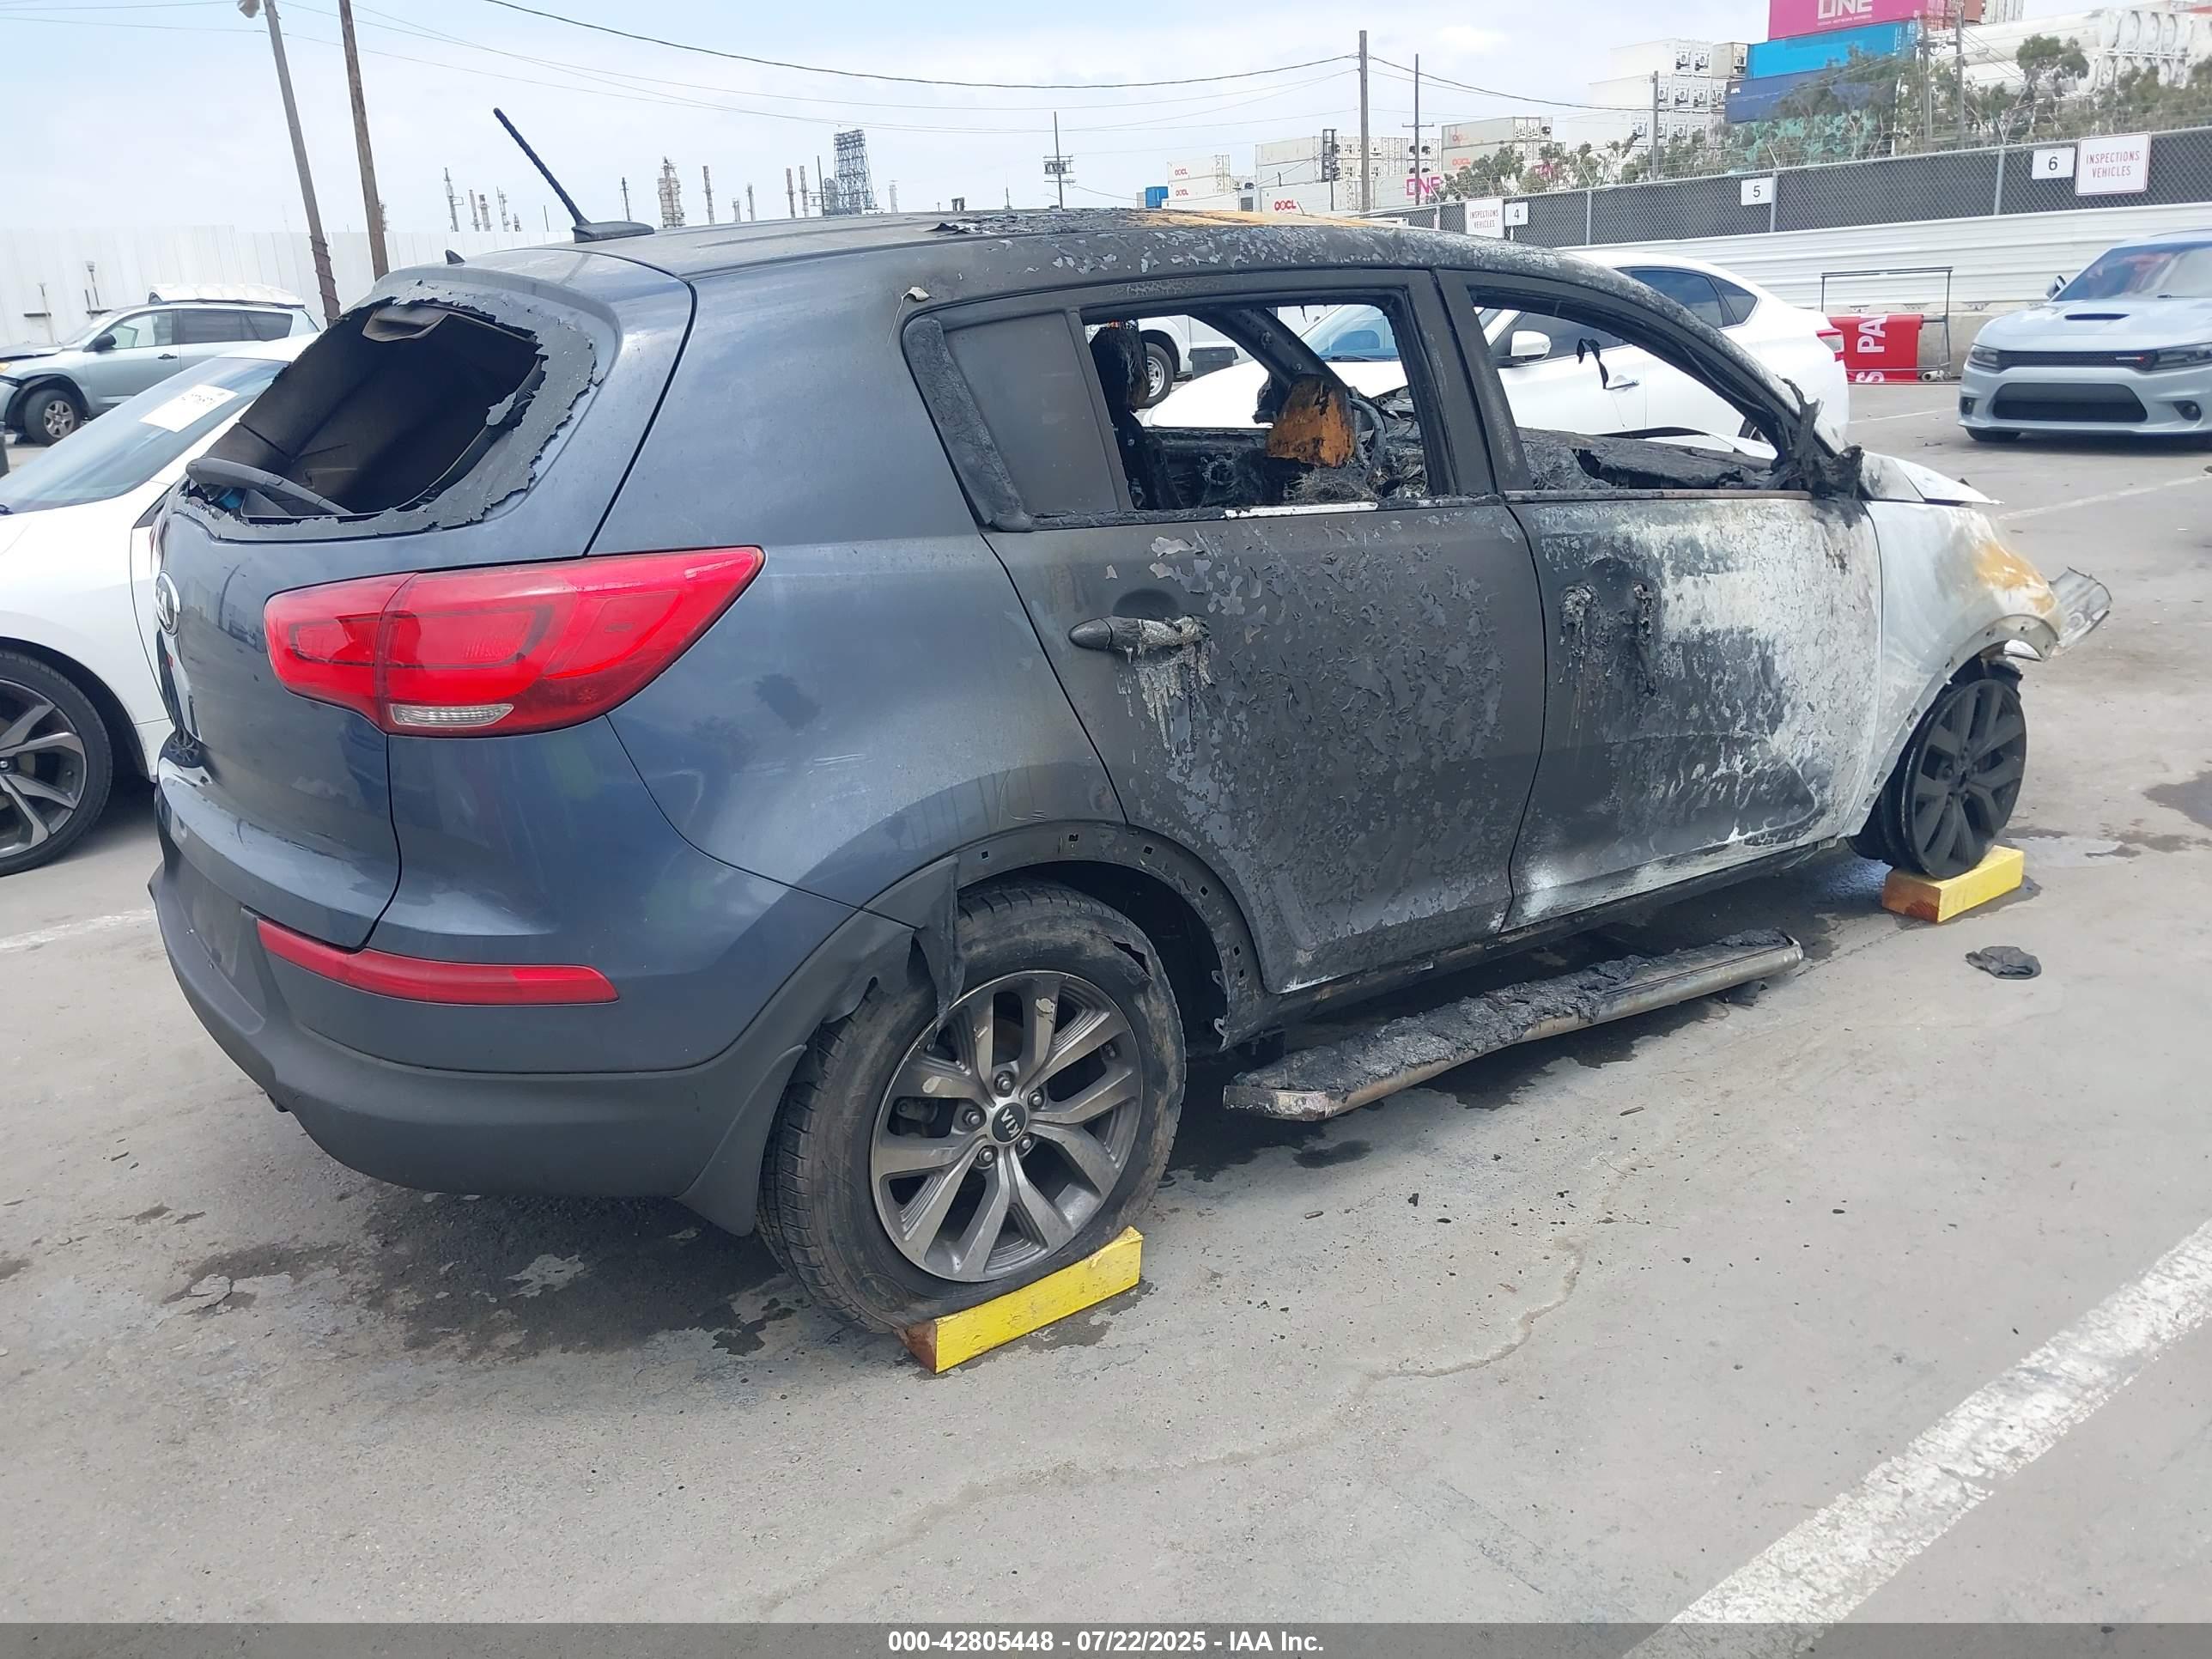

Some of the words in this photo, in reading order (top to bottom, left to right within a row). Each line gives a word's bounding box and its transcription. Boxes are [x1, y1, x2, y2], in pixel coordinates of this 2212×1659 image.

[2048, 156, 2058, 171] 6
[2086, 150, 2140, 165] INSPECTIONS
[2092, 166, 2131, 179] VEHICLES
[1753, 185, 1760, 198] 5
[1274, 199, 1297, 211] OOCL
[1469, 209, 1499, 220] INSPECTIONS
[1514, 209, 1519, 220] 4
[1474, 220, 1496, 229] VEHICLES
[1857, 314, 1887, 353] PA
